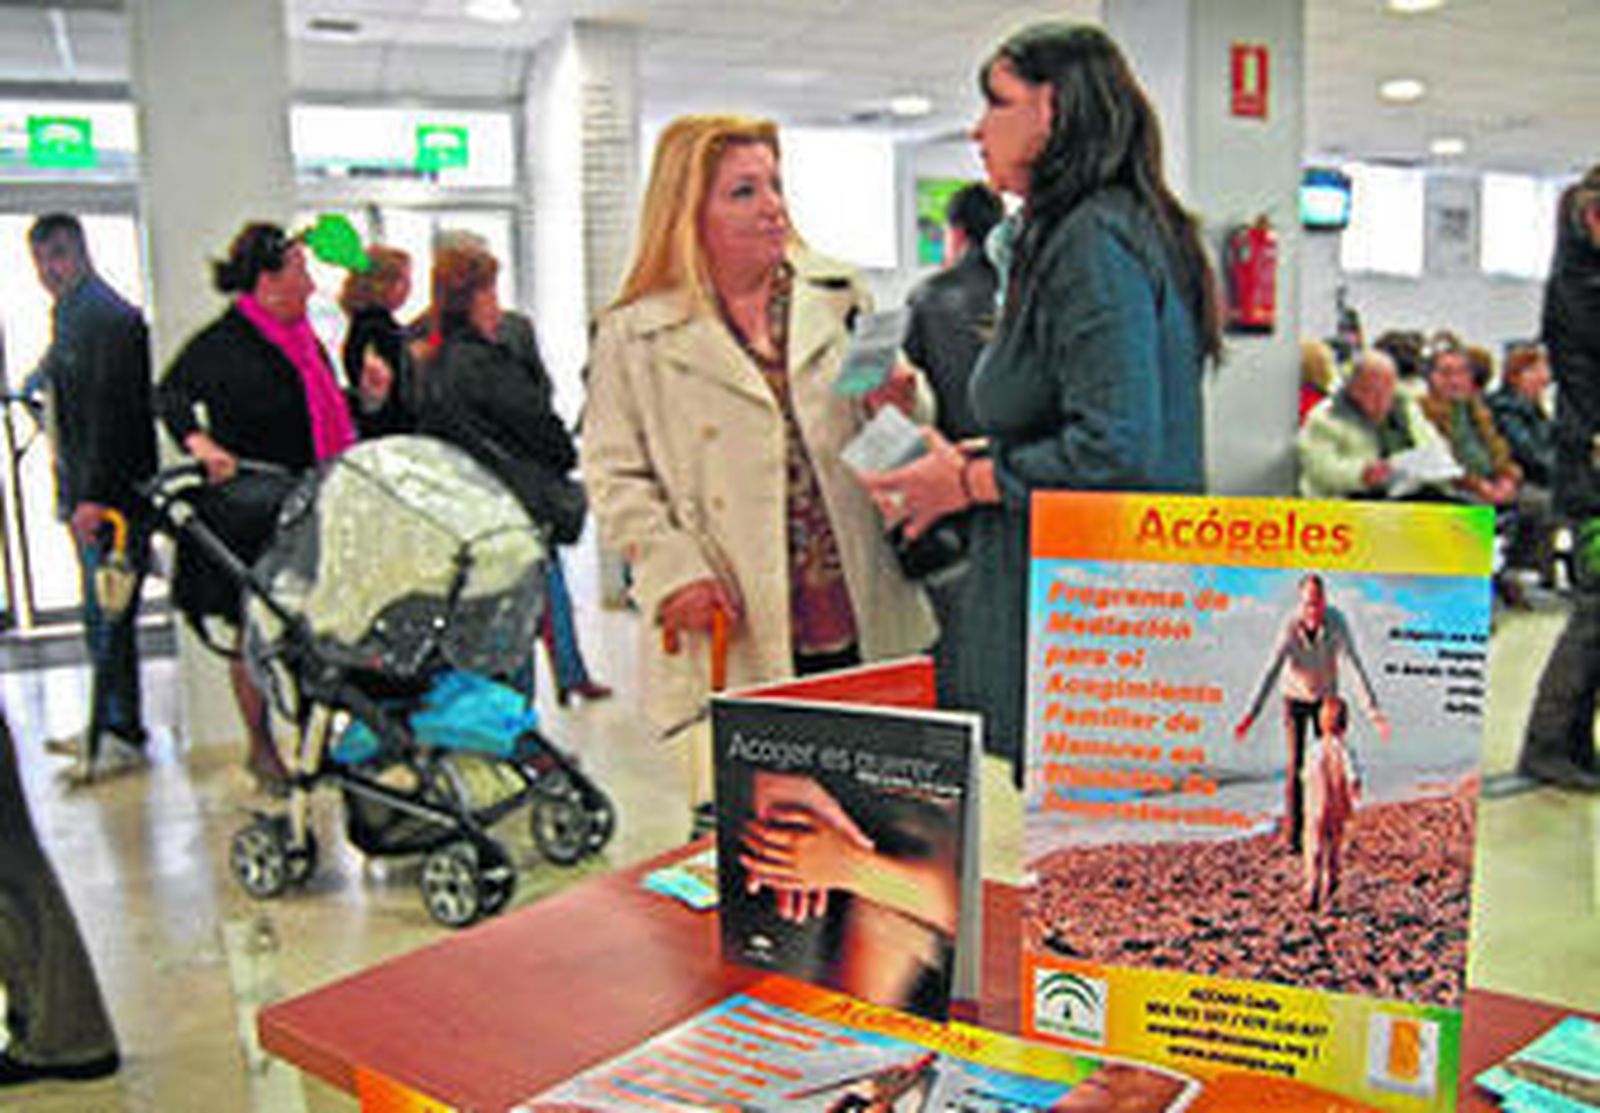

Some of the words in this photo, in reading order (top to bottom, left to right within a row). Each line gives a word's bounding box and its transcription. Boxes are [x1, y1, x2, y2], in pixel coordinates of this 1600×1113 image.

[1136, 507, 1353, 557] Acógeles
[1048, 581, 1186, 610] Programa
[1195, 588, 1230, 612] de
[1045, 647, 1108, 668] para
